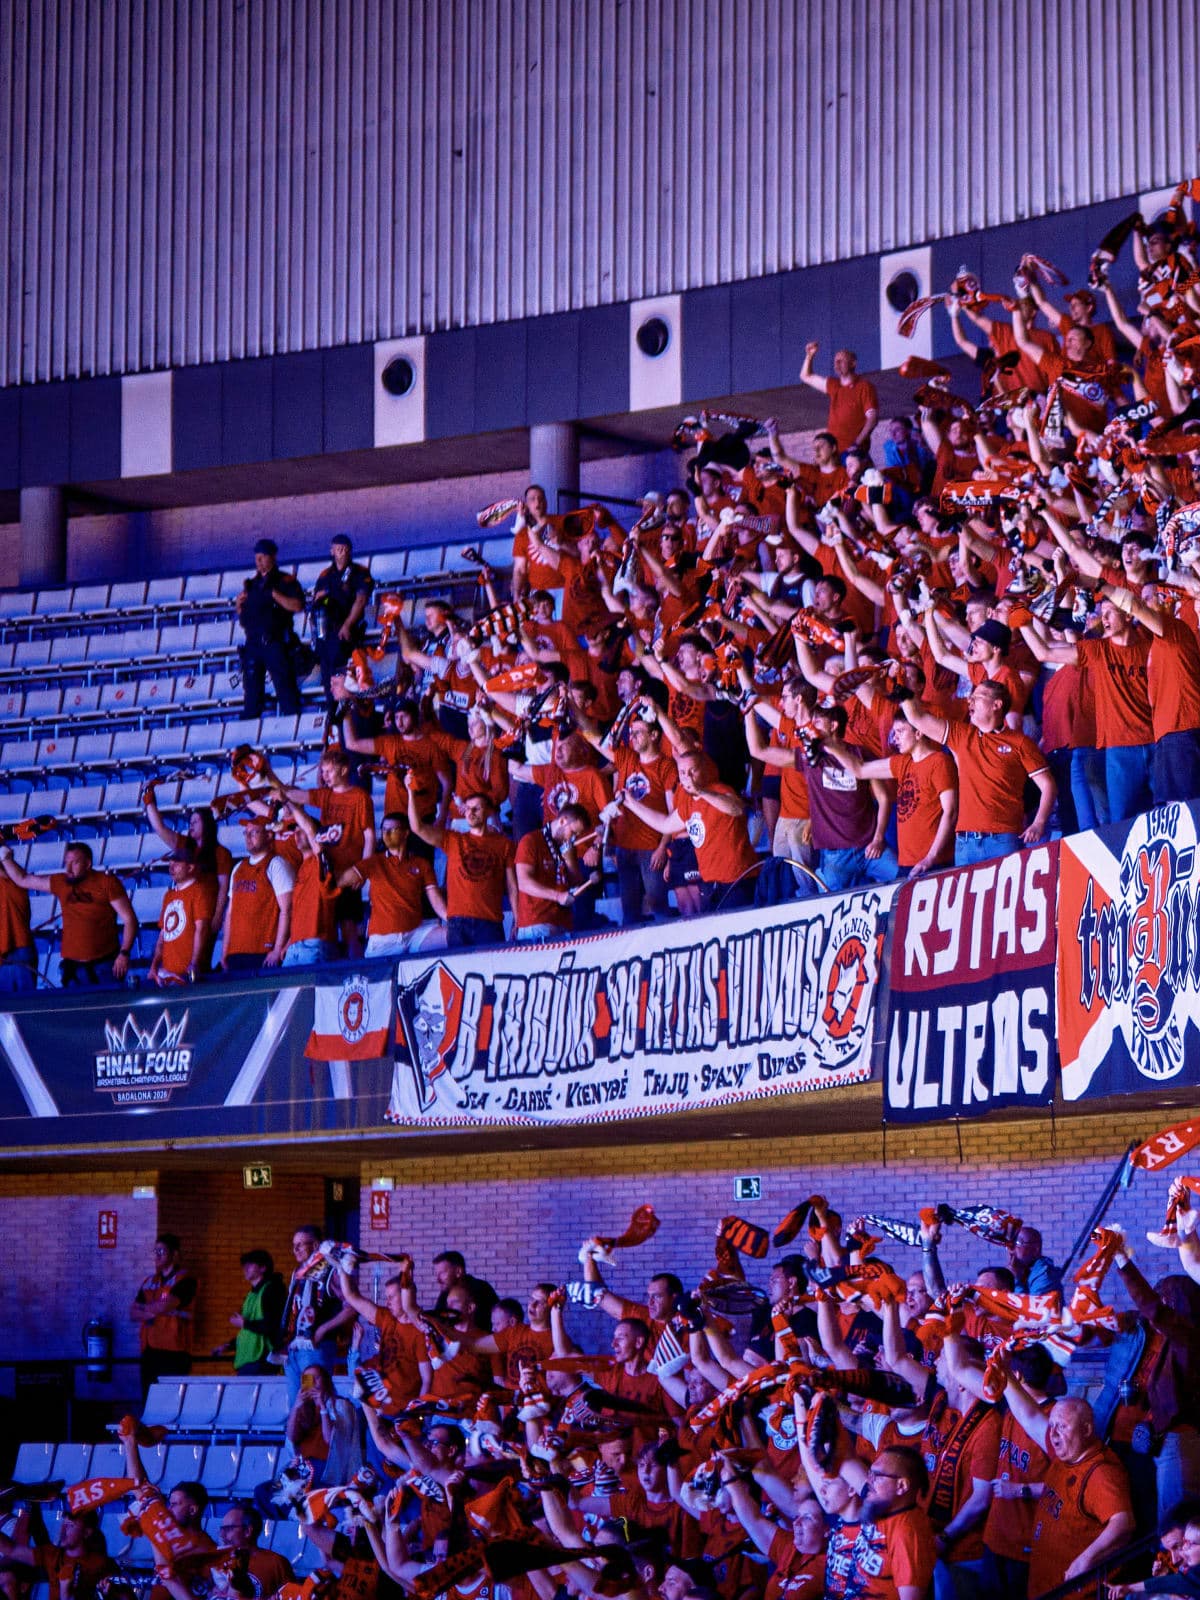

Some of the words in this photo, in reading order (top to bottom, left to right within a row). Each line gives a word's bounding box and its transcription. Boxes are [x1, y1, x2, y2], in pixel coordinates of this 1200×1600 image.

[1146, 803, 1181, 842] 1998
[904, 847, 1052, 978] RYTAS
[832, 917, 873, 951] VILNIUS
[643, 937, 721, 1056] RYTAS
[725, 913, 826, 1050] VILNIUS
[95, 1053, 143, 1078] FINAL
[144, 1049, 192, 1075] FOUR
[887, 986, 1051, 1110] ULTRAS
[117, 1091, 152, 1102] BADALONA
